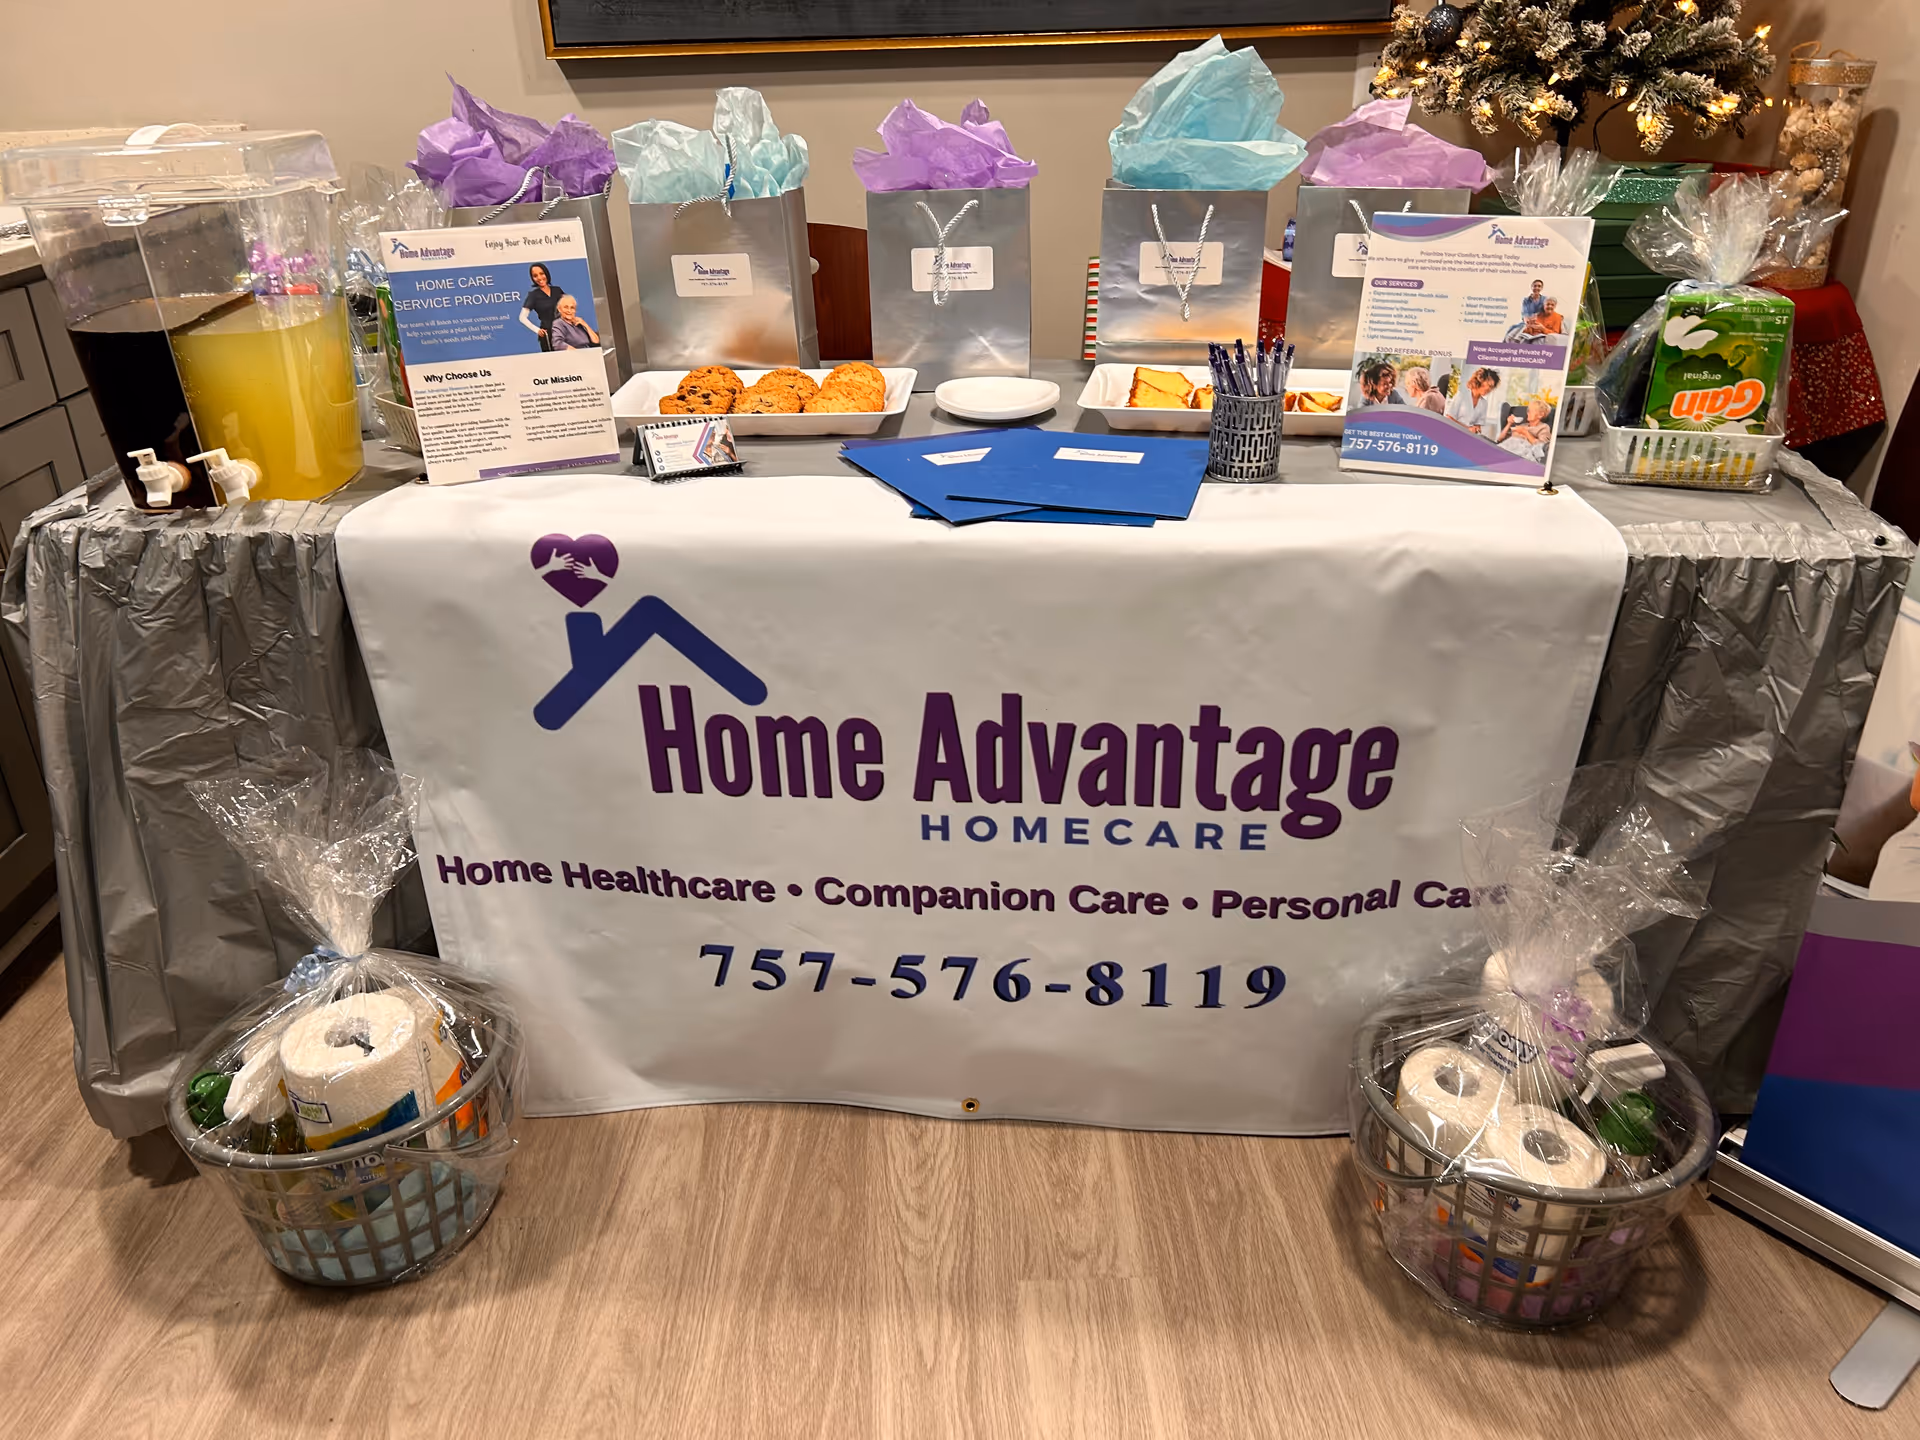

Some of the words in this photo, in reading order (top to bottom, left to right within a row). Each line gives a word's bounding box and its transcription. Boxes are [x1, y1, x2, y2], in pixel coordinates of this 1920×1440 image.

[484, 240, 503, 250] Enjoy
[504, 238, 520, 246] Your
[522, 236, 542, 245] Peace
[544, 235, 552, 245] Of
[554, 234, 570, 242] Mind
[1495, 236, 1513, 245] Home
[1514, 236, 1549, 248] Advantage
[400, 249, 419, 259] Home
[420, 247, 455, 259] Advantage
[416, 278, 455, 290] HOME
[458, 275, 493, 287] CARE
[394, 297, 451, 310] SERVICE
[454, 291, 520, 305] PROVIDER
[1775, 315, 1789, 324] 15
[1487, 347, 1517, 355] Accepting
[423, 374, 443, 382] Why
[445, 372, 477, 380] Choose
[479, 369, 491, 377] Us
[550, 375, 582, 383] Mission
[1684, 371, 1722, 382] original
[1670, 378, 1766, 422] Gain
[1349, 438, 1438, 455] 757-576-8119
[638, 684, 885, 801] Home
[913, 692, 1399, 840] Advantage
[920, 814, 1268, 850] HOMECARE
[436, 854, 552, 886] Home
[561, 861, 776, 902] Healthcare
[814, 877, 1055, 915] Companion
[1068, 884, 1169, 916] Care
[1212, 880, 1400, 920] Personal
[700, 944, 1287, 1008] 757-576-8119
